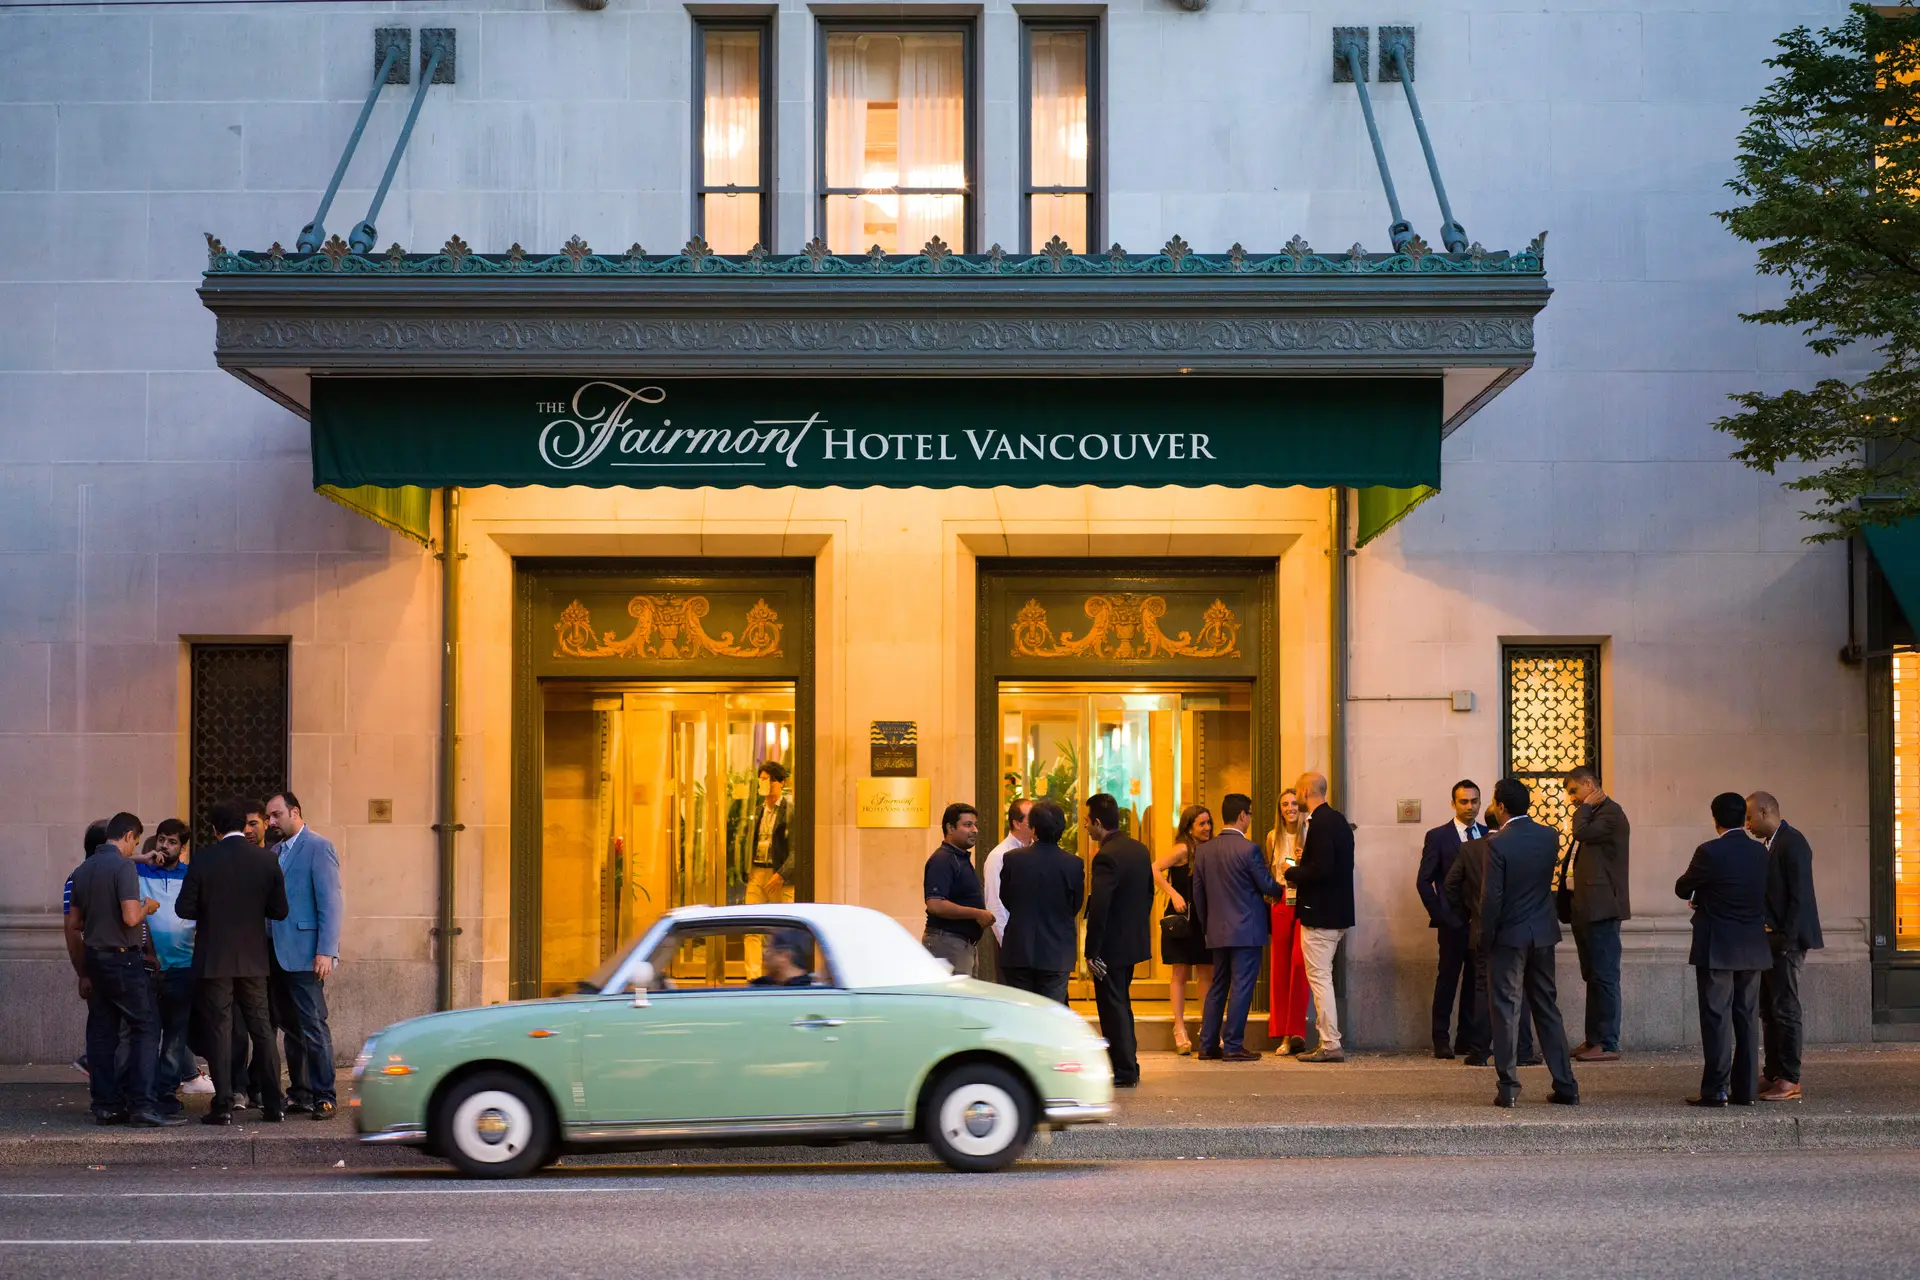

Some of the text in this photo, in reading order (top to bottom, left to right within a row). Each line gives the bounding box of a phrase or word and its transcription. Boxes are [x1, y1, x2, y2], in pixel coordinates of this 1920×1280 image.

[536, 381, 1217, 469] THE Fairmont HOTEL VANCOUVER
